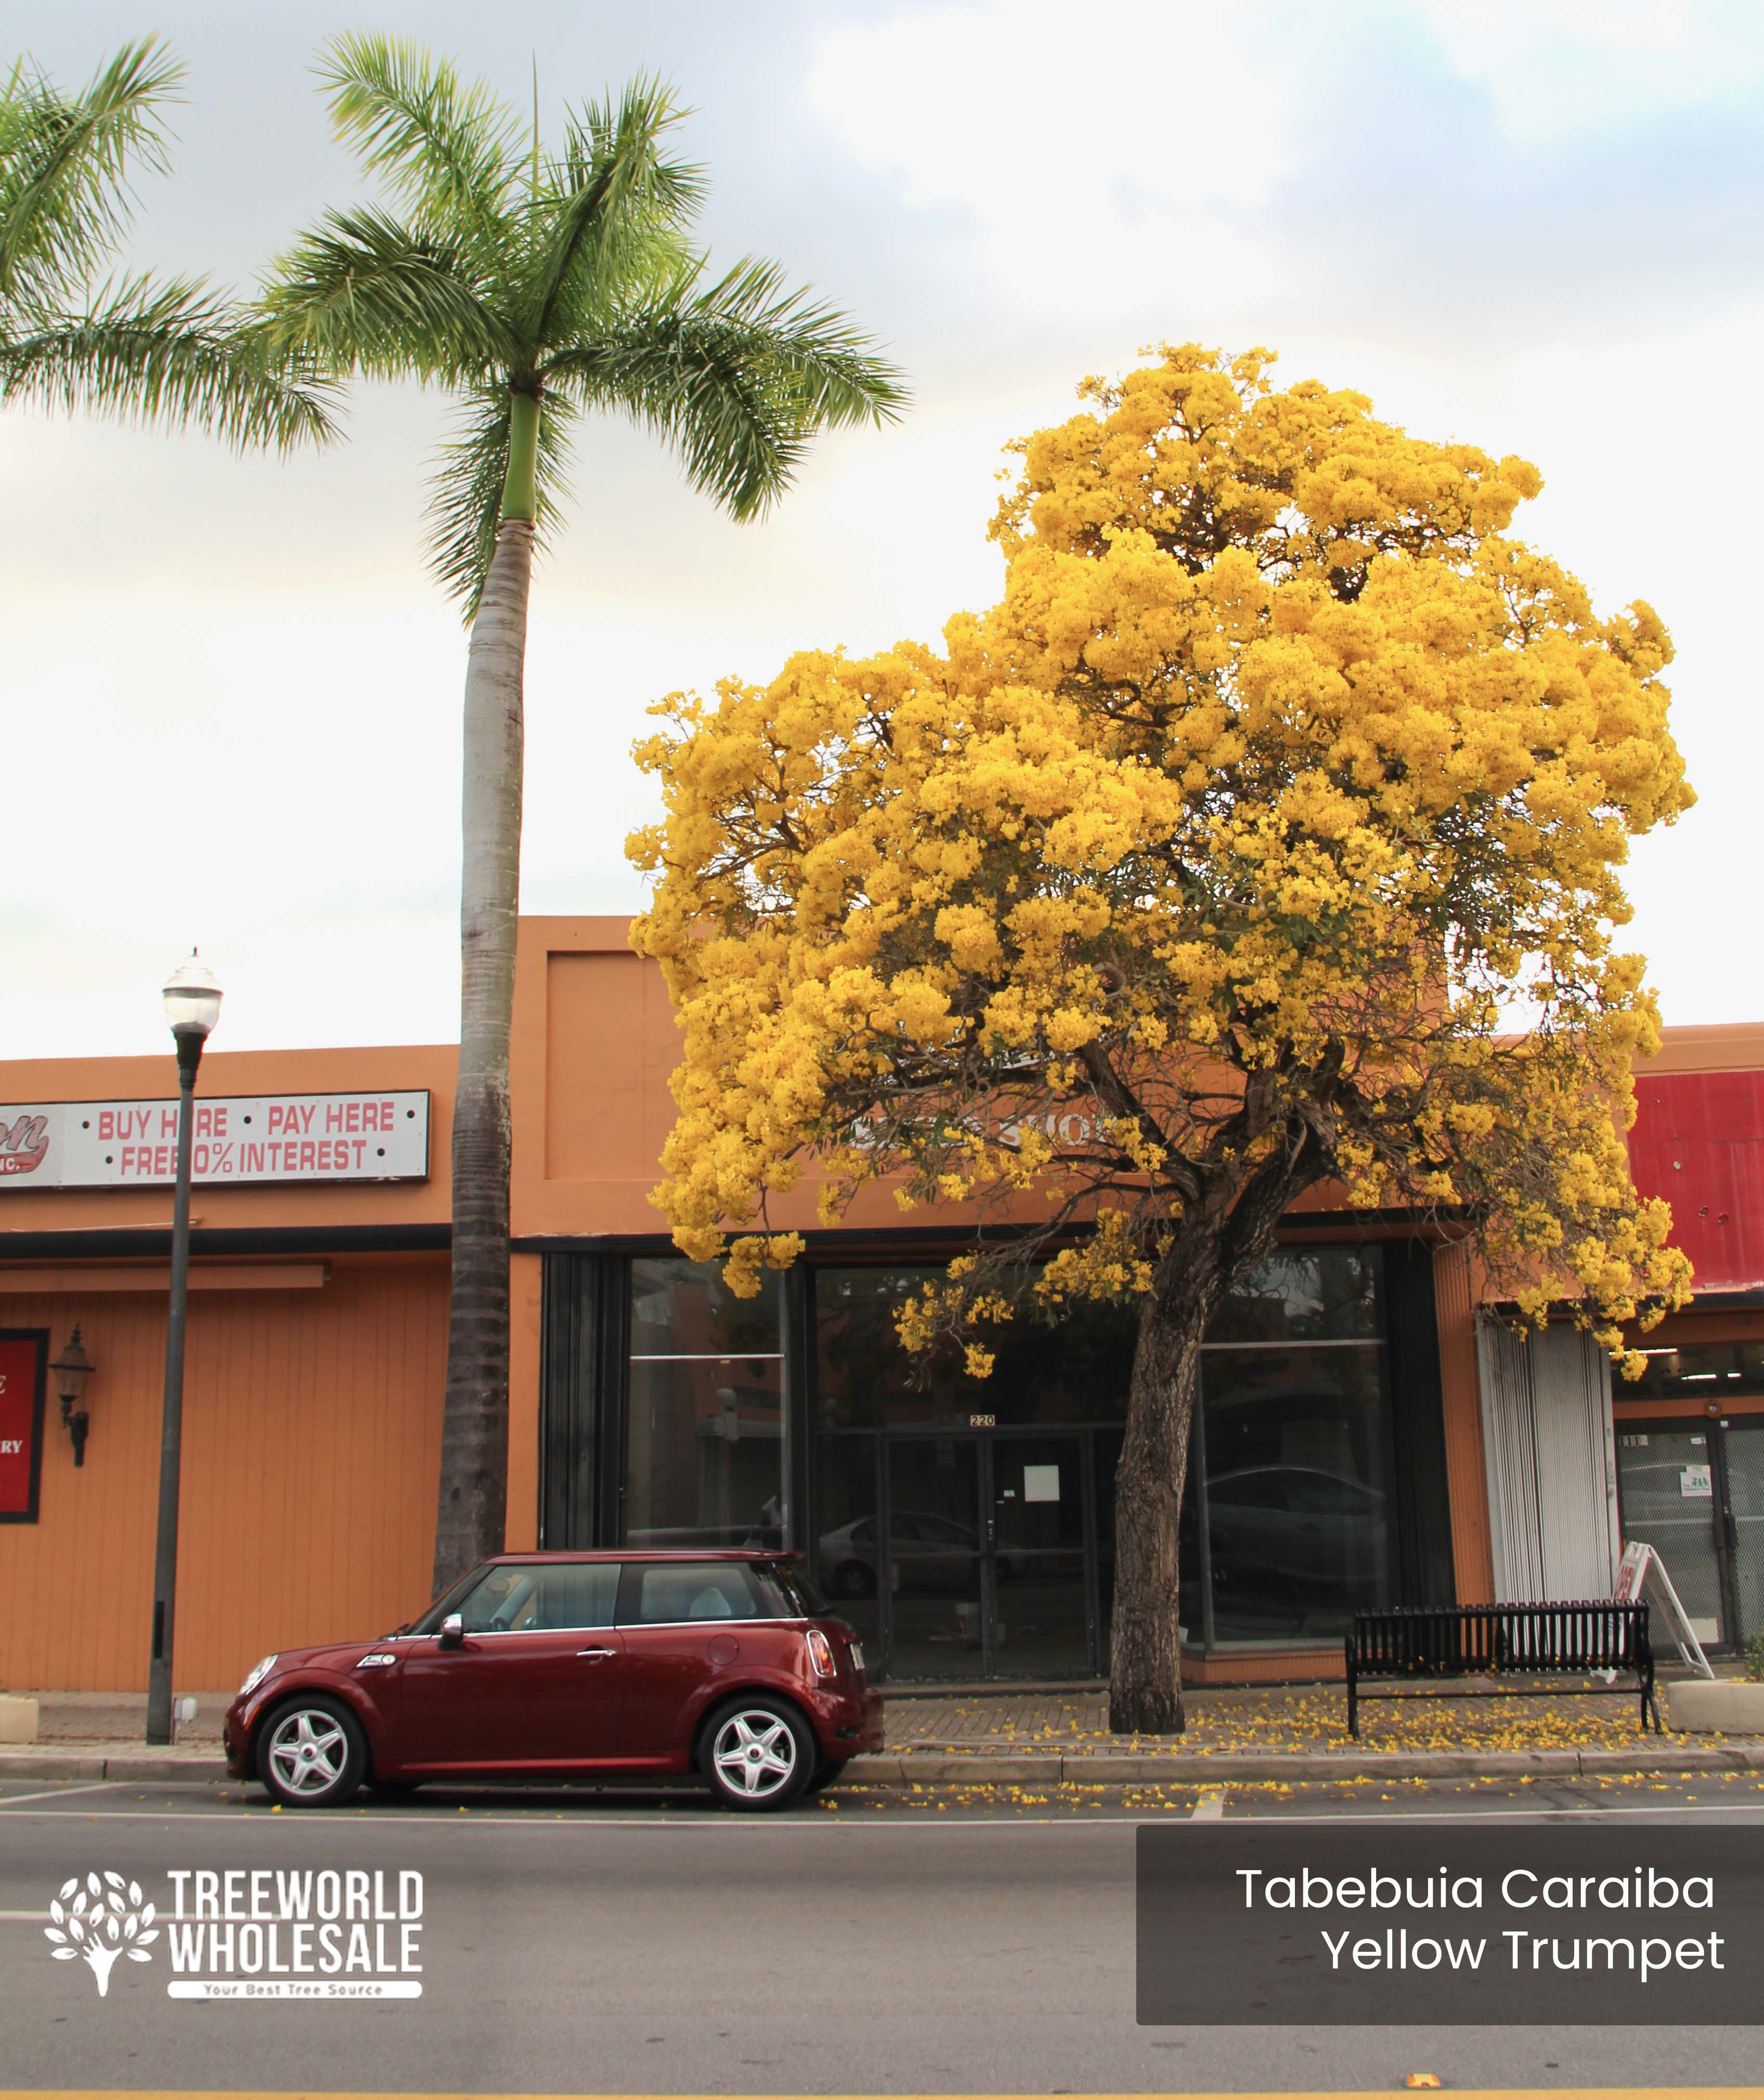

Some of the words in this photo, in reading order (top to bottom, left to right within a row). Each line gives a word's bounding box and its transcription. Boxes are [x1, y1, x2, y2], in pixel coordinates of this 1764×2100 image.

[99, 1110, 152, 1140] BUY
[161, 1108, 228, 1138] HRE
[268, 1105, 316, 1135] PAY
[326, 1101, 395, 1133] HERE
[193, 1142, 234, 1174] 0%
[240, 1139, 367, 1172] INTEREST
[971, 1416, 994, 1425] 220
